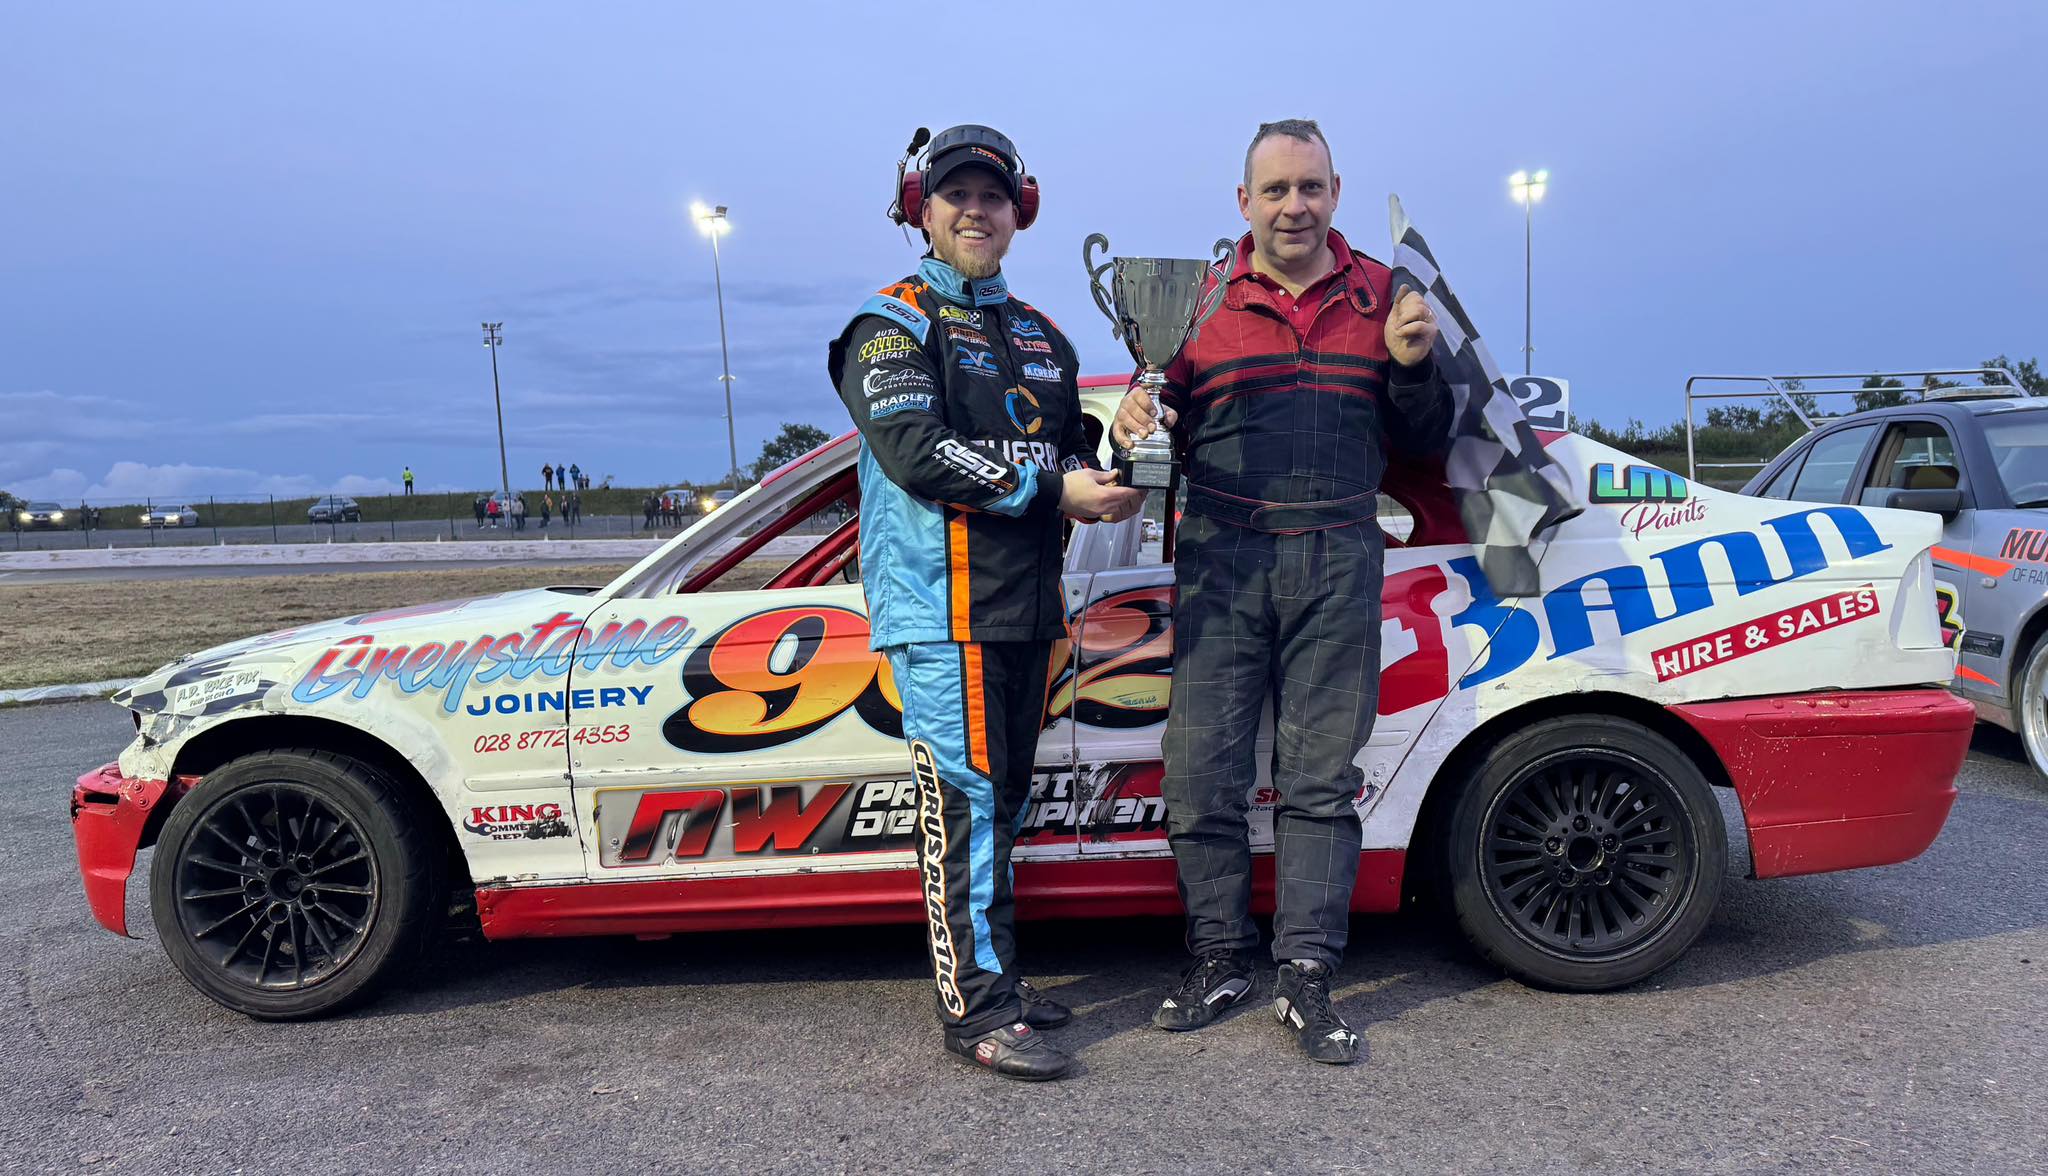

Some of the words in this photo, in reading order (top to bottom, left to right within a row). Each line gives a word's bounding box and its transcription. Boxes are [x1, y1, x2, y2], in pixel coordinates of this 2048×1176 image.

[980, 285, 1000, 297] RSD
[881, 303, 921, 323] RSD
[875, 328, 899, 338] AUTO
[870, 350, 911, 365] BELFAST
[871, 393, 934, 411] BRADLEY
[931, 452, 1007, 495] RACEWEAR
[936, 438, 1008, 480] RSD
[1620, 496, 1712, 541] Paints
[2012, 567, 2028, 582] OF
[1657, 633, 1734, 677] HIRE
[1744, 625, 1770, 649] &
[1777, 590, 1875, 639] SALES
[290, 611, 701, 714] Greystone
[178, 685, 200, 703] A.D.
[204, 675, 234, 693] RACE
[236, 670, 260, 687] PIX
[466, 685, 655, 718] JOINERY
[473, 733, 512, 755] 028
[517, 729, 569, 751] 8772
[571, 723, 632, 746] 4353
[470, 803, 562, 824] KING
[912, 741, 946, 864] CIRRUS
[924, 859, 965, 1018] PLASTICS
